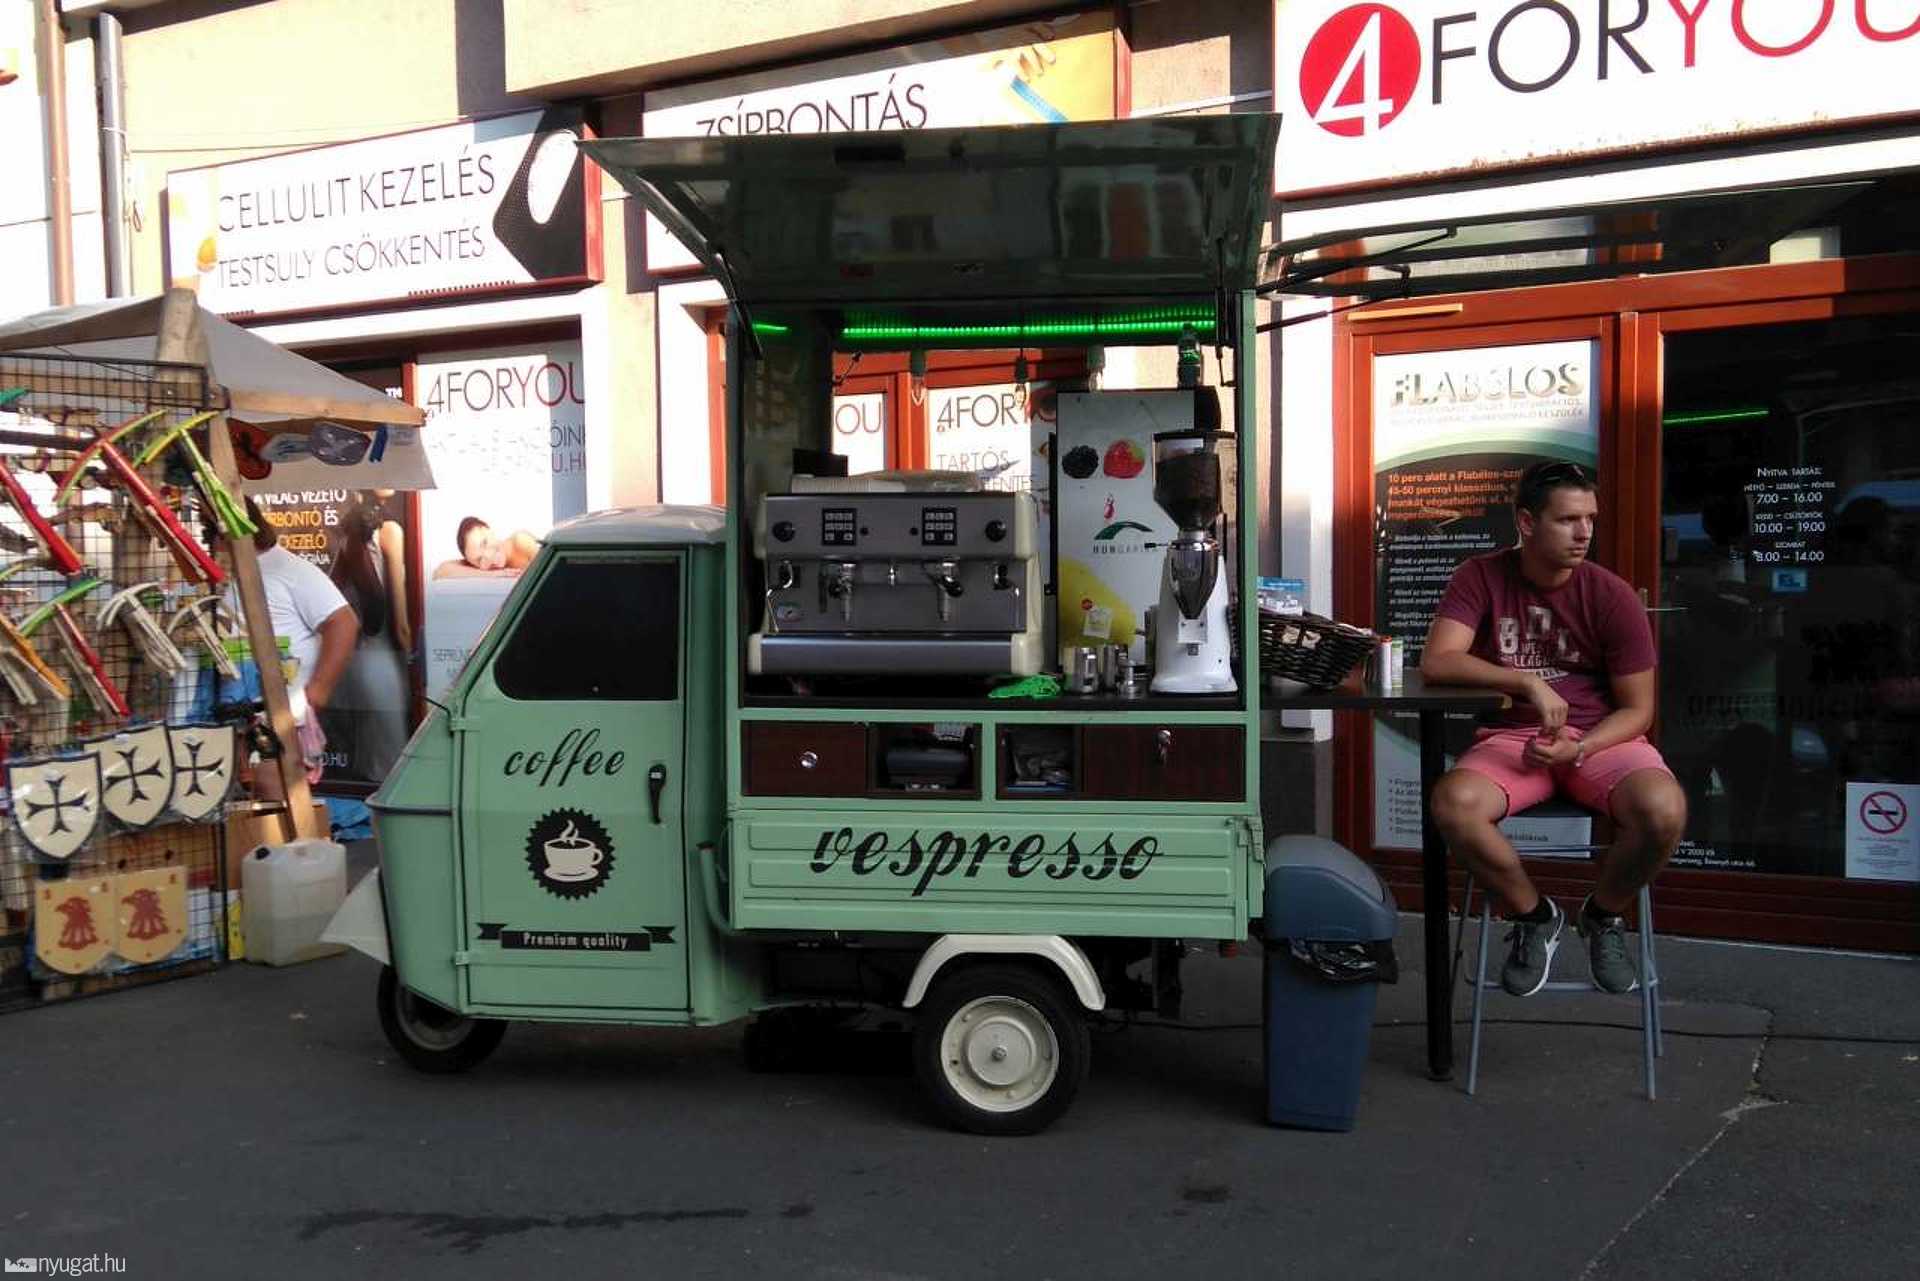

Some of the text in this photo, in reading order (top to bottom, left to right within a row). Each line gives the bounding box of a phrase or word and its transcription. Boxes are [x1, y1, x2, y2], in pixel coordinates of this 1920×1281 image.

[218, 143, 497, 233] CELLULIT KEZELÉS
[218, 219, 487, 289] TESTSULY CSÖKKENTÉS
[1794, 491, 1823, 504] 16.00
[1754, 522, 1783, 533] 10.00
[1798, 521, 1825, 532] 19.00
[1795, 551, 1825, 562] 14.00
[503, 728, 625, 787] coffee
[809, 827, 1163, 897] vespresso
[523, 932, 628, 950] Premium quality
